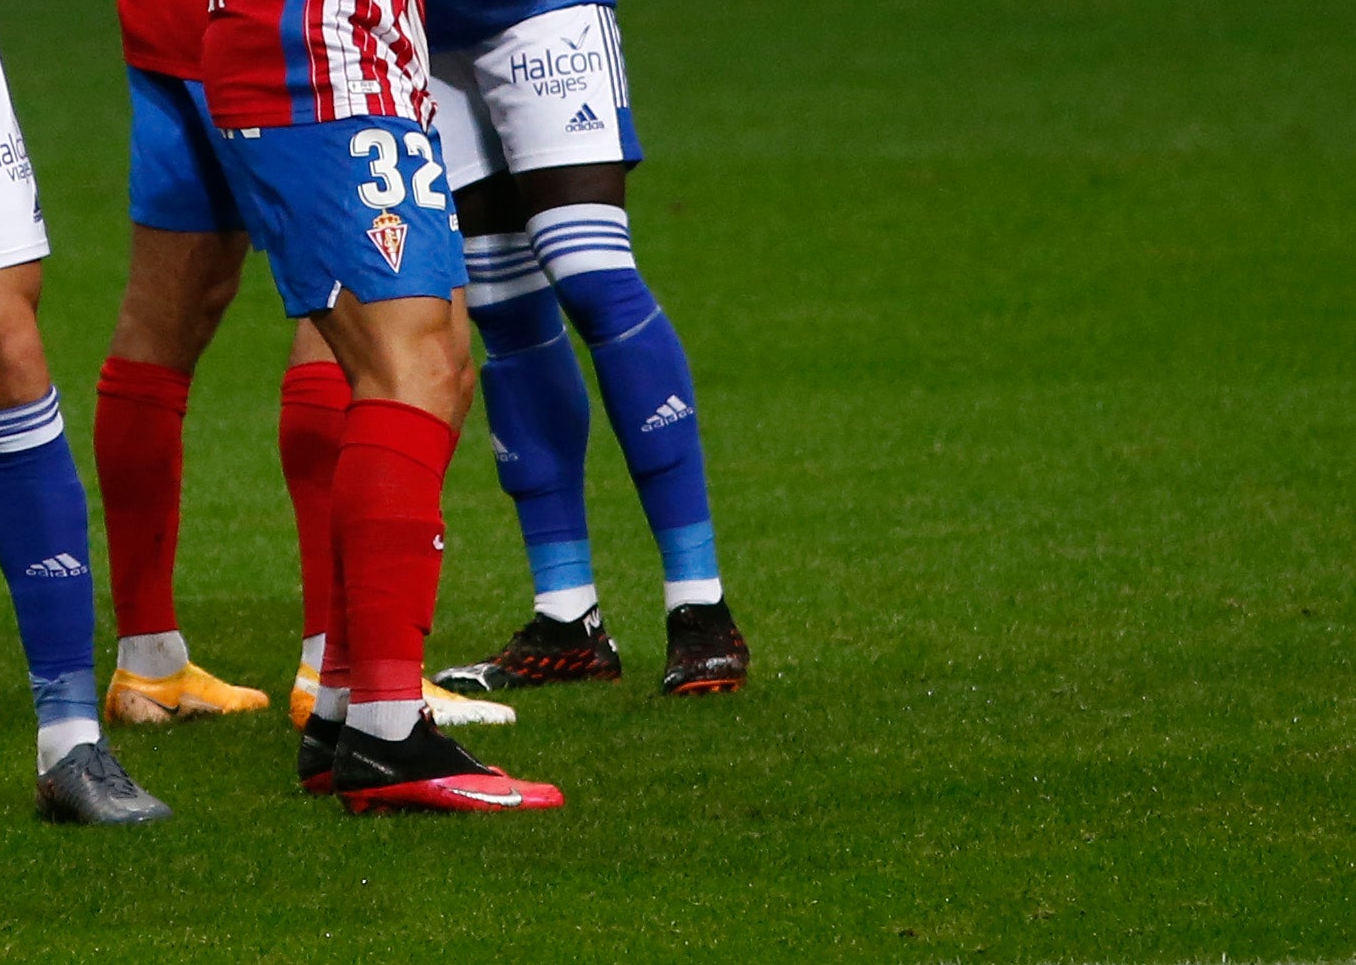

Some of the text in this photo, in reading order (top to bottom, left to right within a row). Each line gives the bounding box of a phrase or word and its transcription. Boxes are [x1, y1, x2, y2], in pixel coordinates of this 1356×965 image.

[533, 76, 587, 99] viajes
[565, 120, 606, 133] adidas
[349, 128, 446, 211] 32
